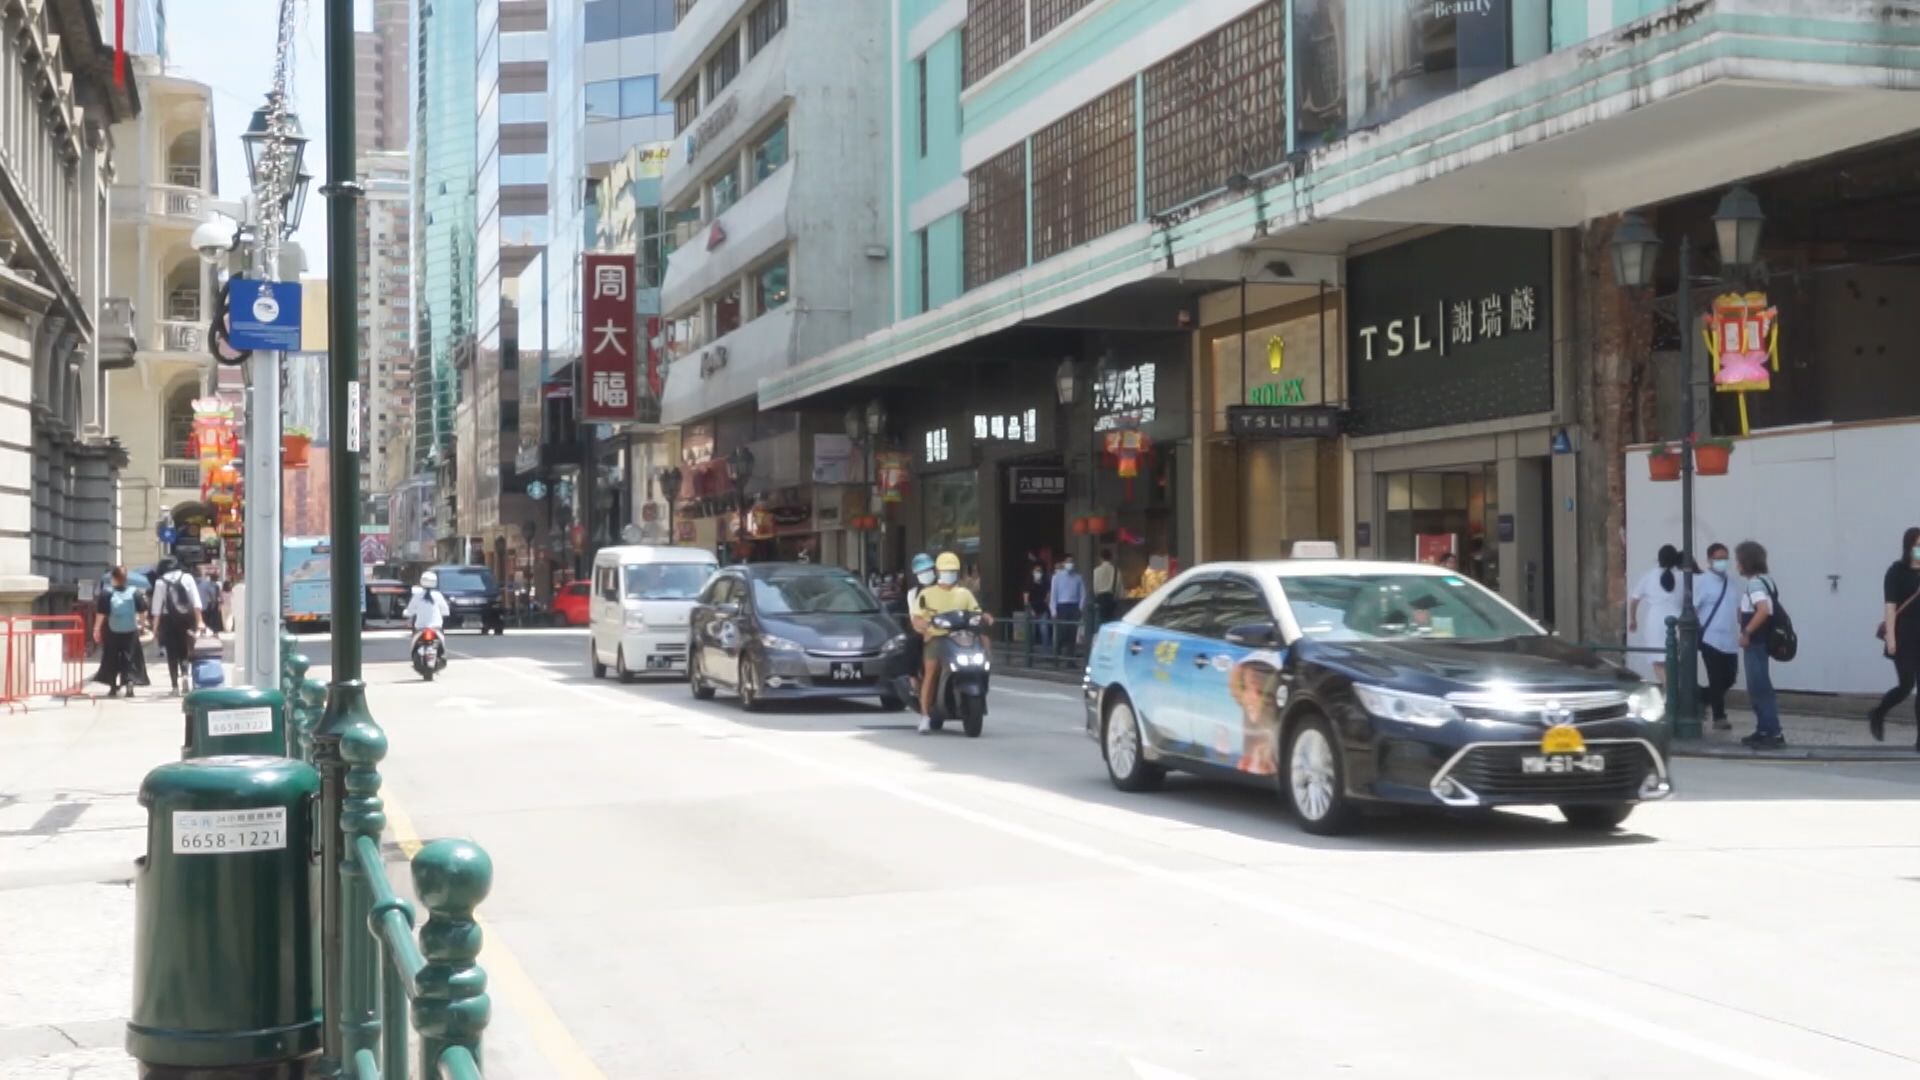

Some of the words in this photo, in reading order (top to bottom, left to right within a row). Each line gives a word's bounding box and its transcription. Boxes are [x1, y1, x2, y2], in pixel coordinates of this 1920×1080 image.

[1435, 0, 1491, 19] Beauty
[1360, 315, 1431, 360] TSL
[1452, 286, 1535, 344] 謝瑞麟
[593, 264, 628, 408] 周大福
[1248, 377, 1305, 406] ROLEX
[1242, 415, 1280, 428] TSL
[181, 829, 280, 848] 6658-1221
